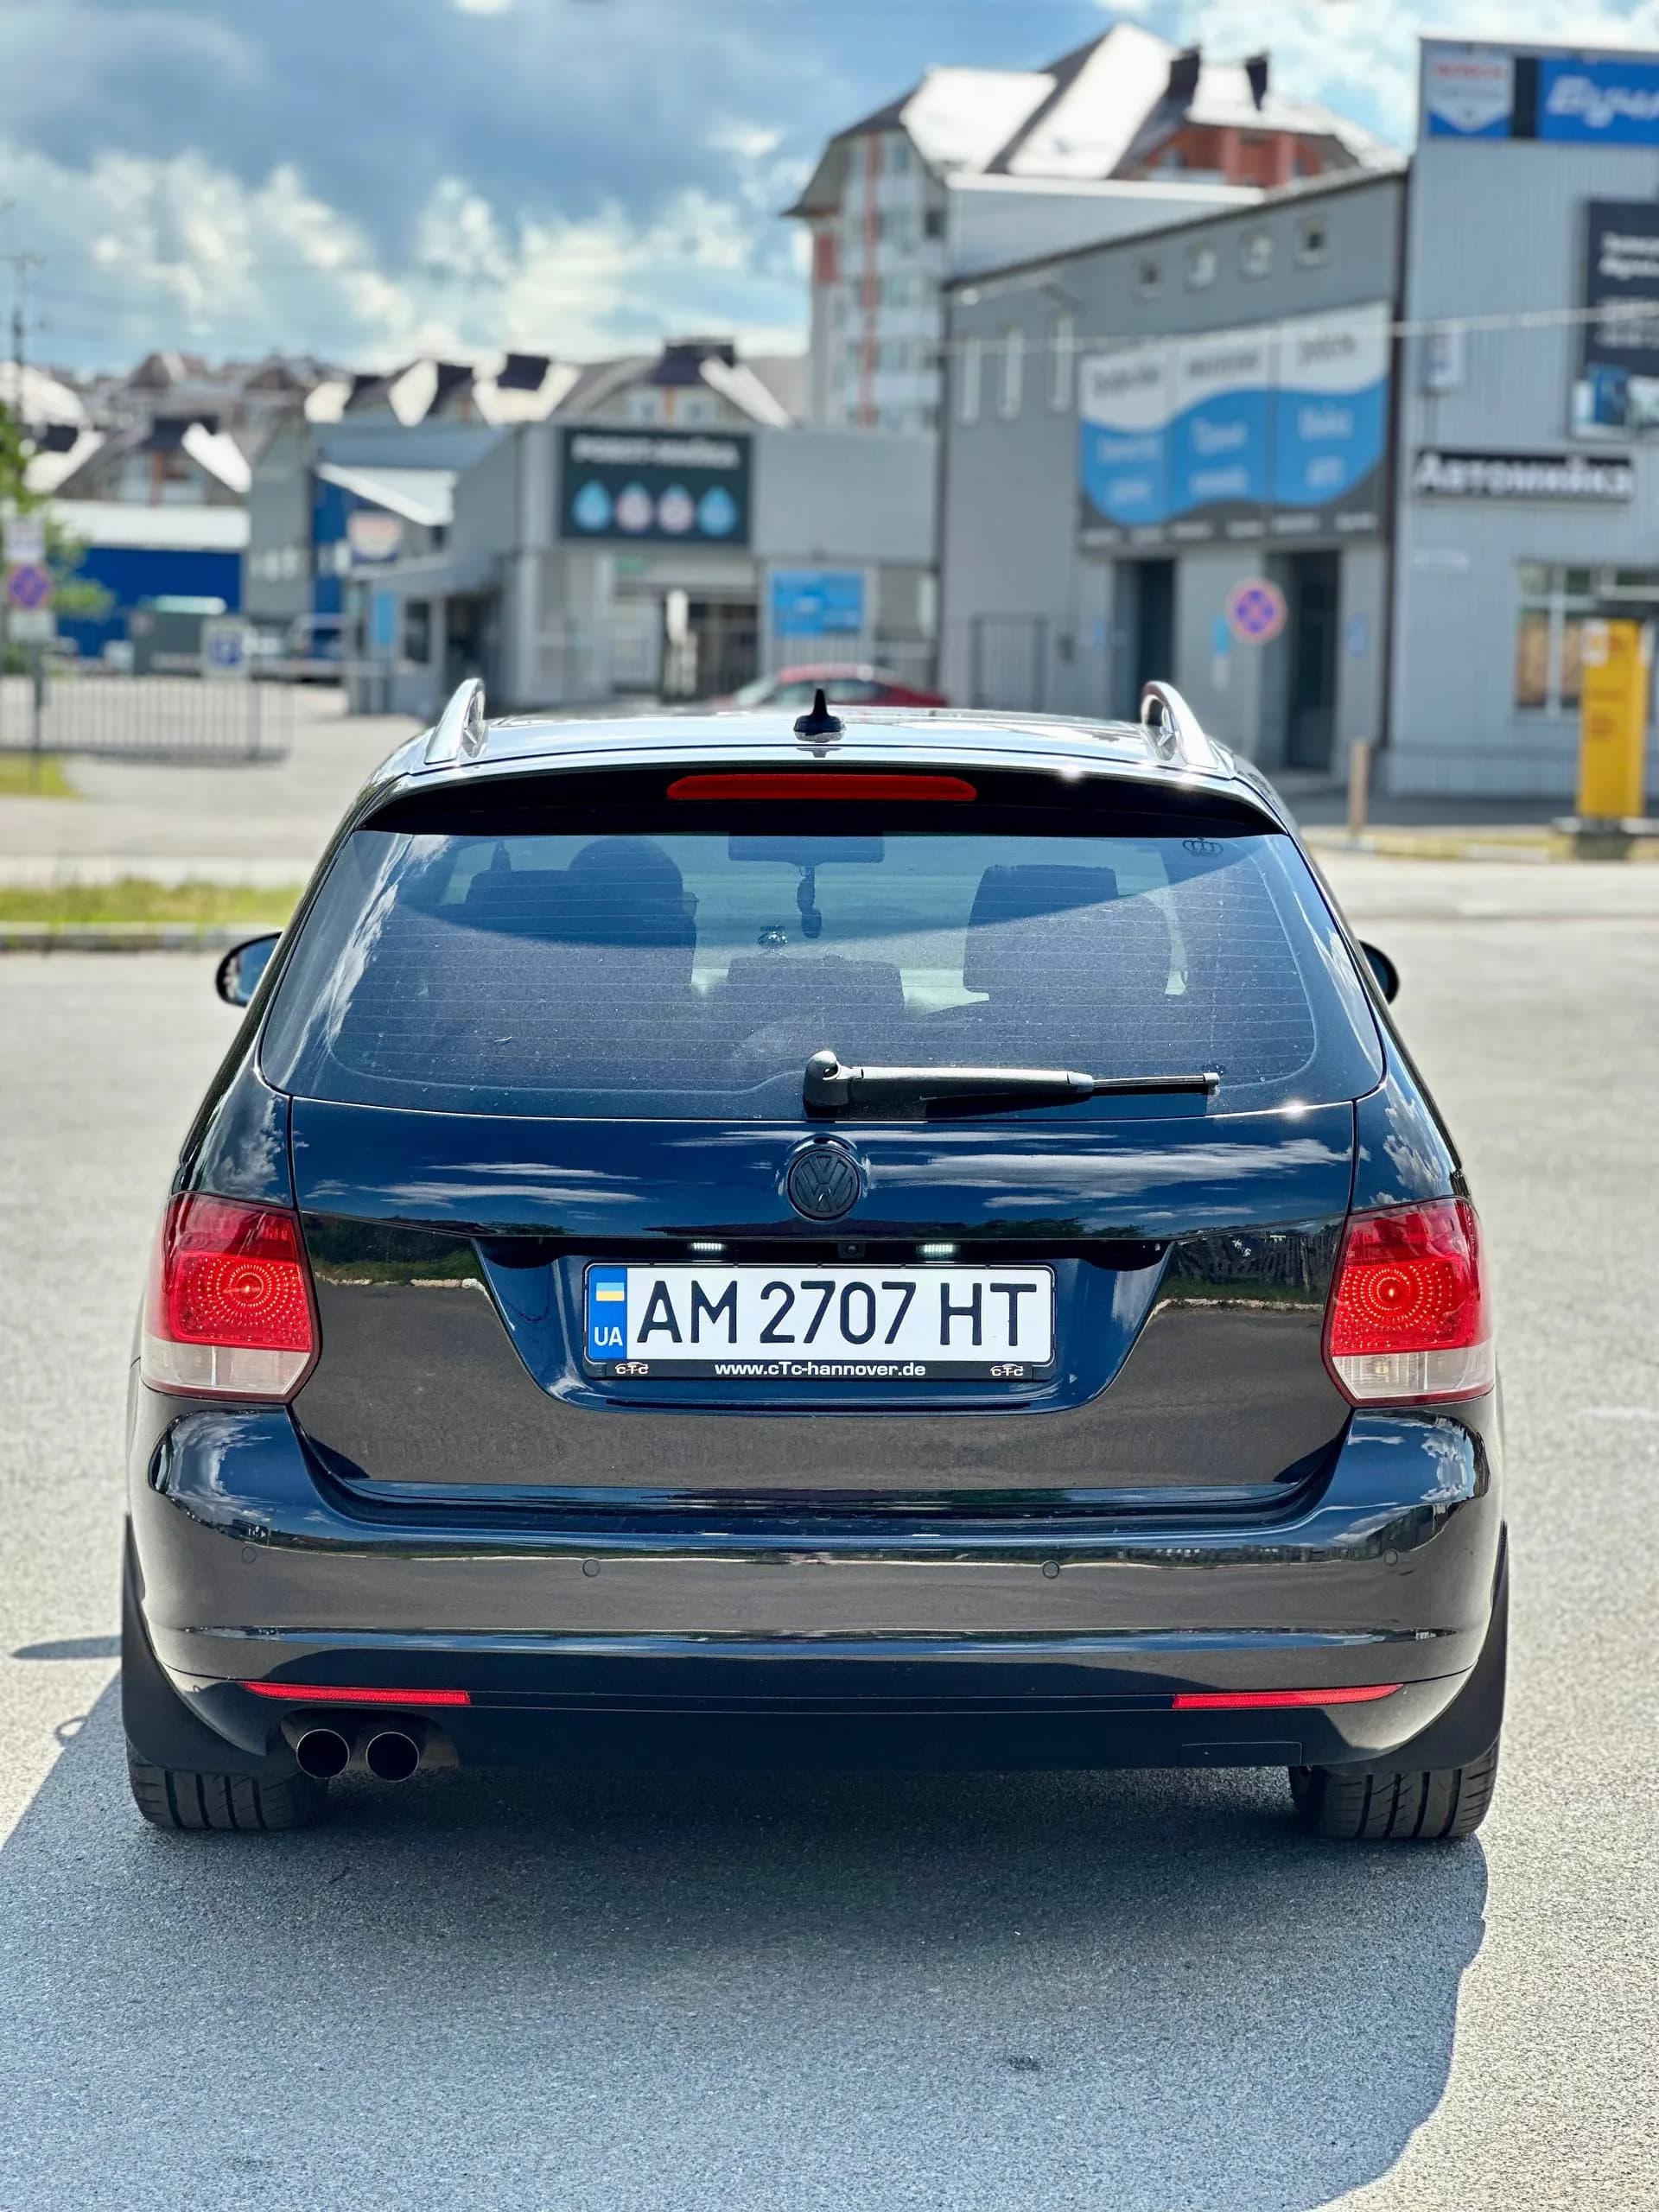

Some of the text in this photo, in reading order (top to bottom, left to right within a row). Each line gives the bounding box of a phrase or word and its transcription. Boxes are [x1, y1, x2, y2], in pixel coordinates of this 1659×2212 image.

[637, 1281, 1037, 1346] AM 2707 HT
[594, 1326, 624, 1347] UA
[715, 1361, 926, 1376] www.cTc-hannover.de
